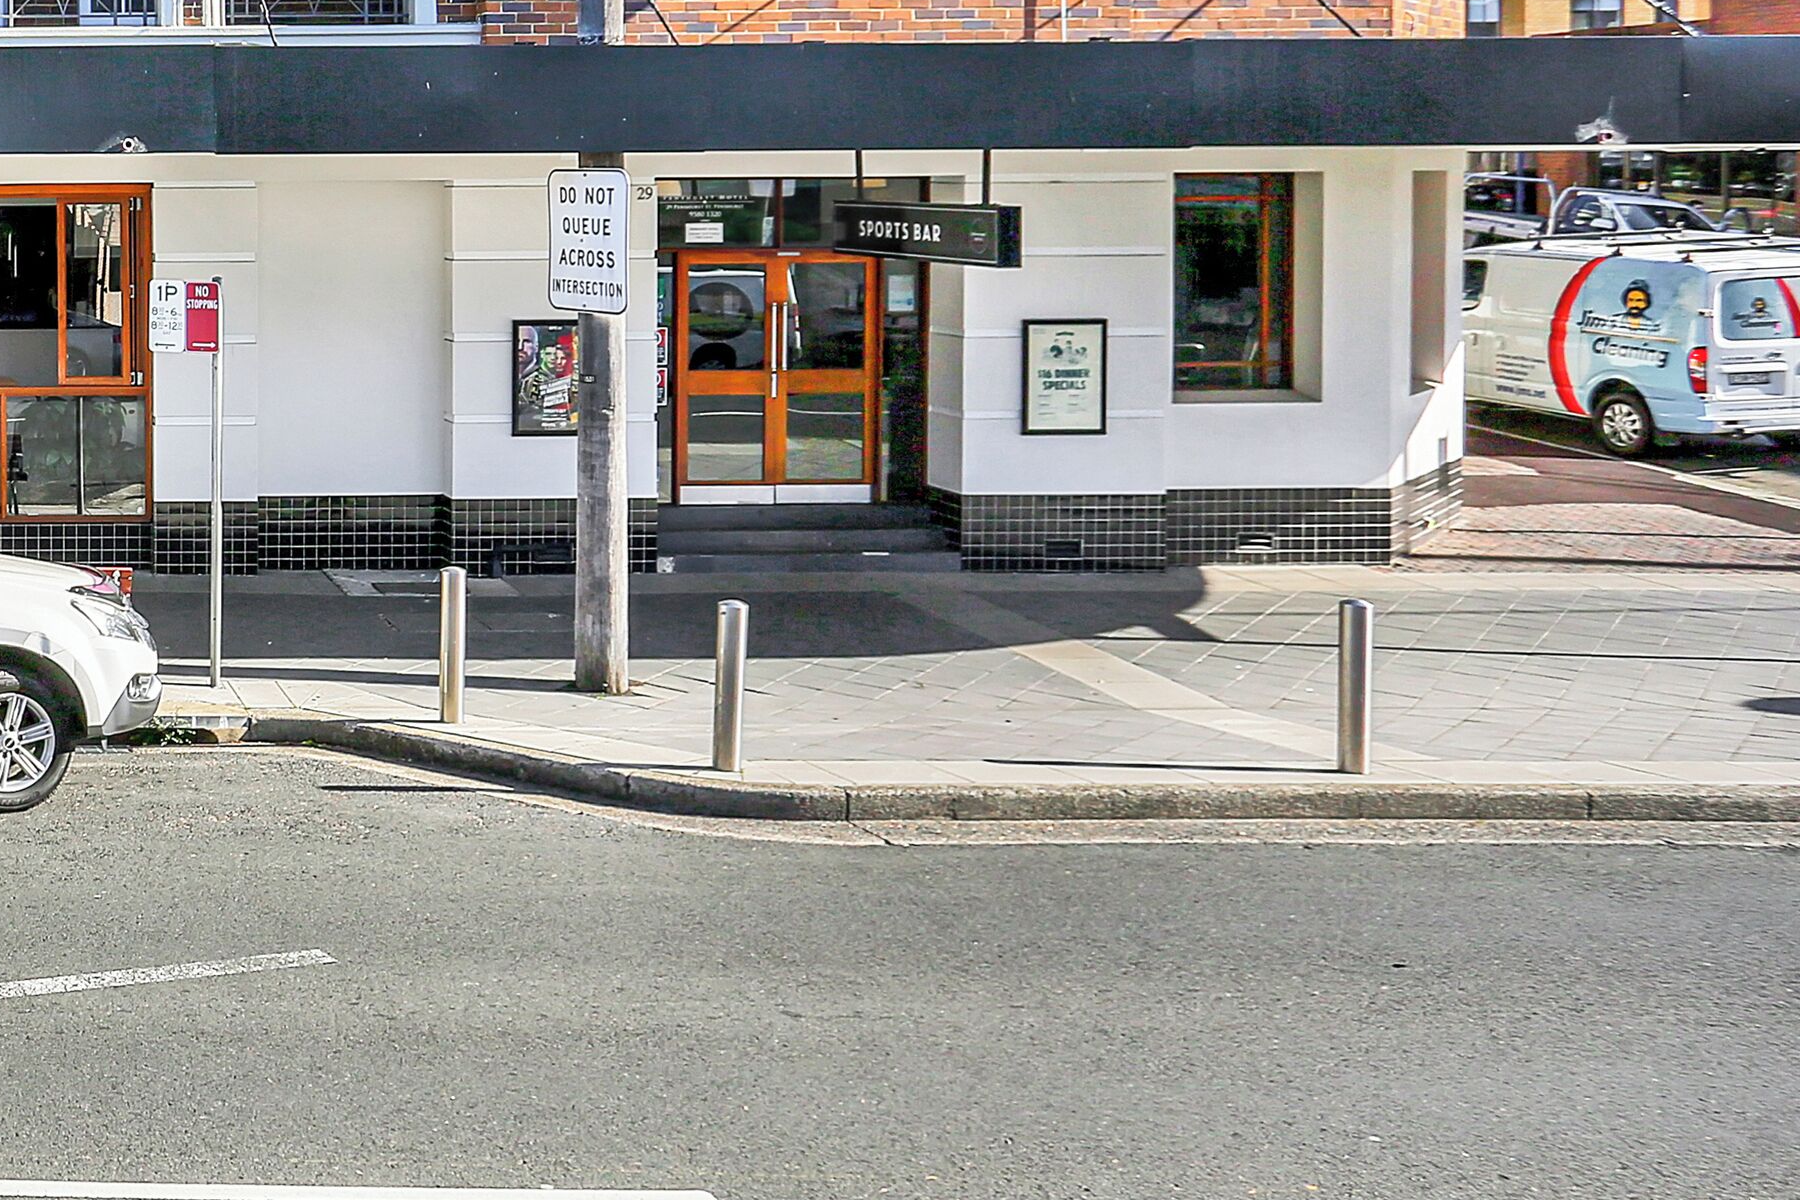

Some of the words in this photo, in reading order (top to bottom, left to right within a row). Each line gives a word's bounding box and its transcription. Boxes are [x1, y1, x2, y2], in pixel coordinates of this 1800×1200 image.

[559, 186, 577, 204] DO
[585, 187, 615, 205] NOT
[636, 186, 654, 200] 29
[562, 216, 611, 236] QUEUE
[859, 219, 909, 240] SPORTS
[913, 223, 941, 242] BAR
[559, 248, 616, 269] ACROSS
[157, 285, 178, 302] 1P
[194, 285, 210, 297] NO
[552, 278, 623, 298] INTERSECTION
[186, 299, 218, 310] STOPPING
[1592, 336, 1671, 369] Cleaning
[1054, 368, 1090, 378] DINNER
[1042, 380, 1087, 391] SPECIALS
